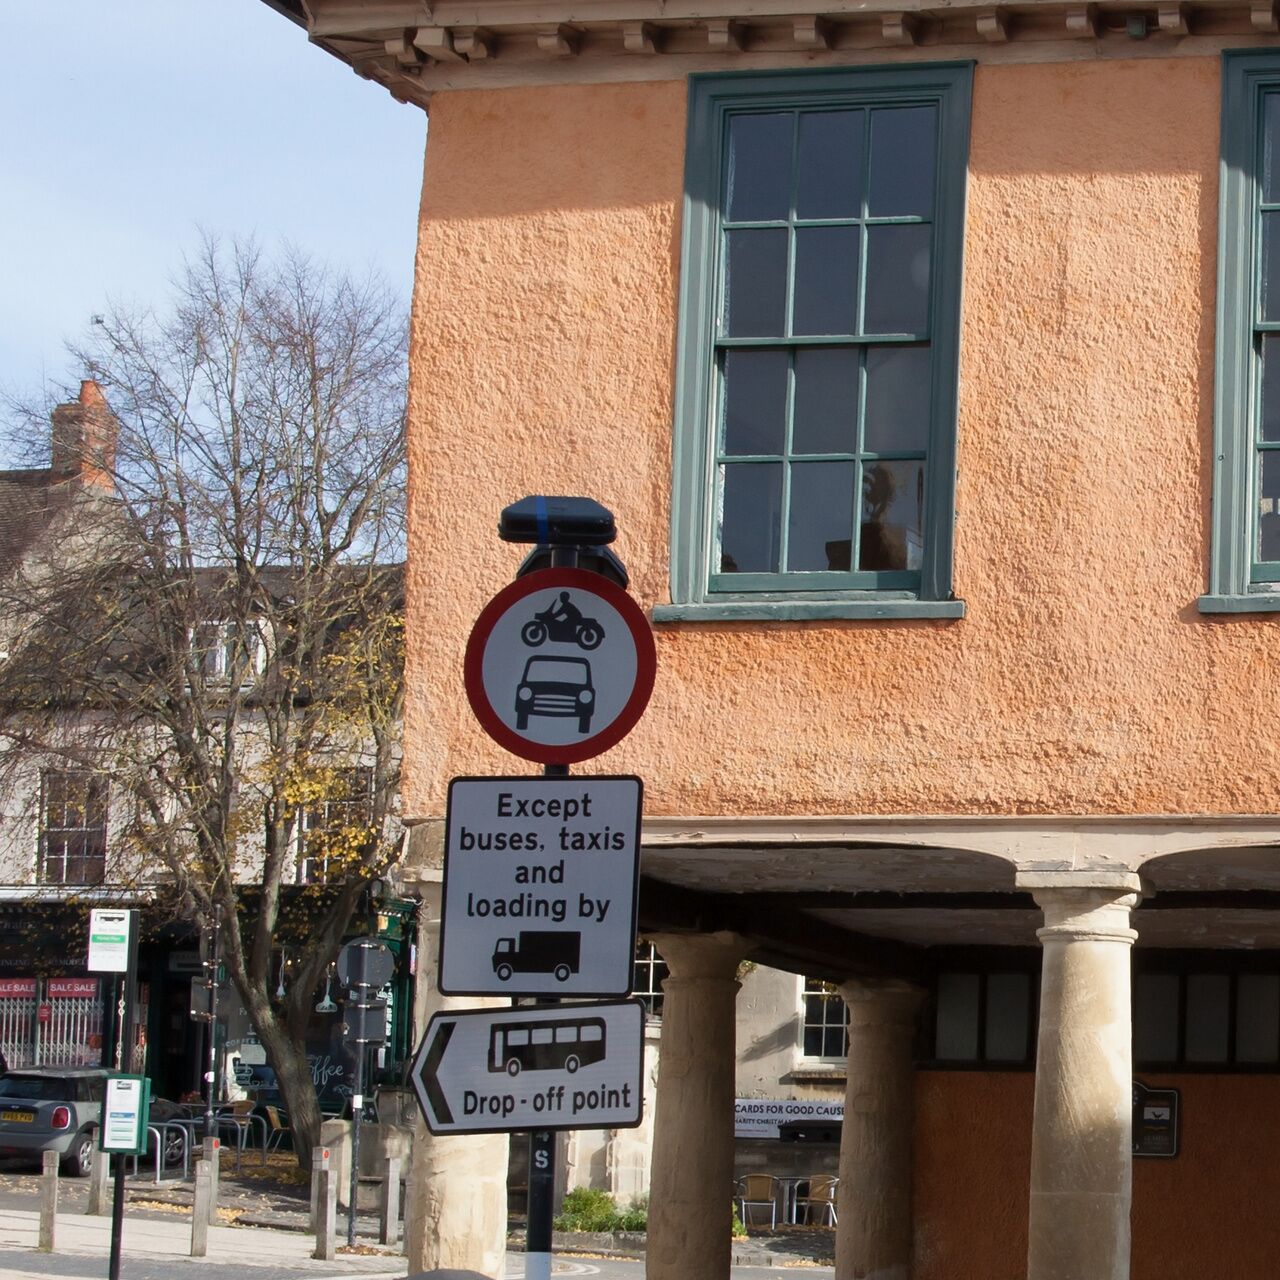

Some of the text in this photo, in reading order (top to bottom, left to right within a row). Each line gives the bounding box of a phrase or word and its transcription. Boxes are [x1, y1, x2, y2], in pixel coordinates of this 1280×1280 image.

[497, 792, 592, 822] Except
[459, 826, 625, 852] buses, taxis
[514, 859, 565, 884] and
[467, 892, 611, 922] loading by
[13, 984, 36, 992] SALE
[50, 983, 96, 992] SALE SALE
[572, 1082, 631, 1115] point
[734, 1104, 764, 1114] CARDS
[766, 1105, 784, 1114] FOR
[785, 1105, 814, 1115] GOOD
[535, 1149, 548, 1169] S
